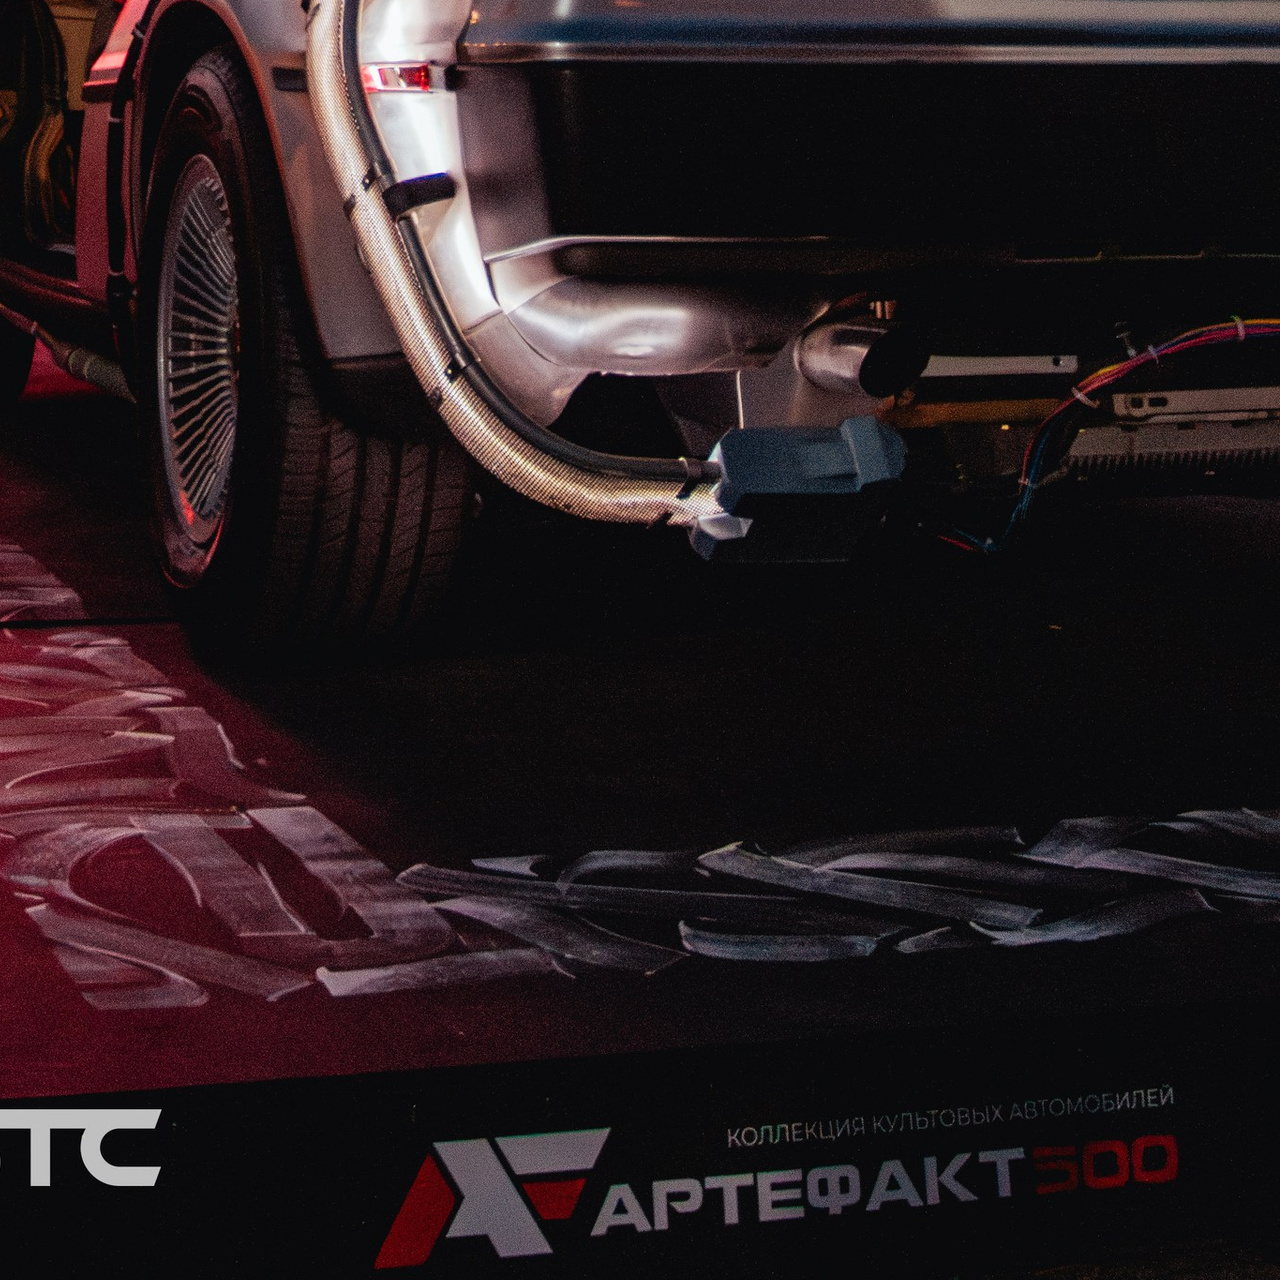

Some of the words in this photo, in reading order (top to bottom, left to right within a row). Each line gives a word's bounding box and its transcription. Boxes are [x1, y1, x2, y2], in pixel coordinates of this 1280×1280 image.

[727, 1117, 866, 1148] КОЛЛЕКЦИЯ
[872, 1105, 1004, 1134] КУЛЬТОВЫХ
[1009, 1085, 1175, 1121] АВТОМОБИЛЕЙ
